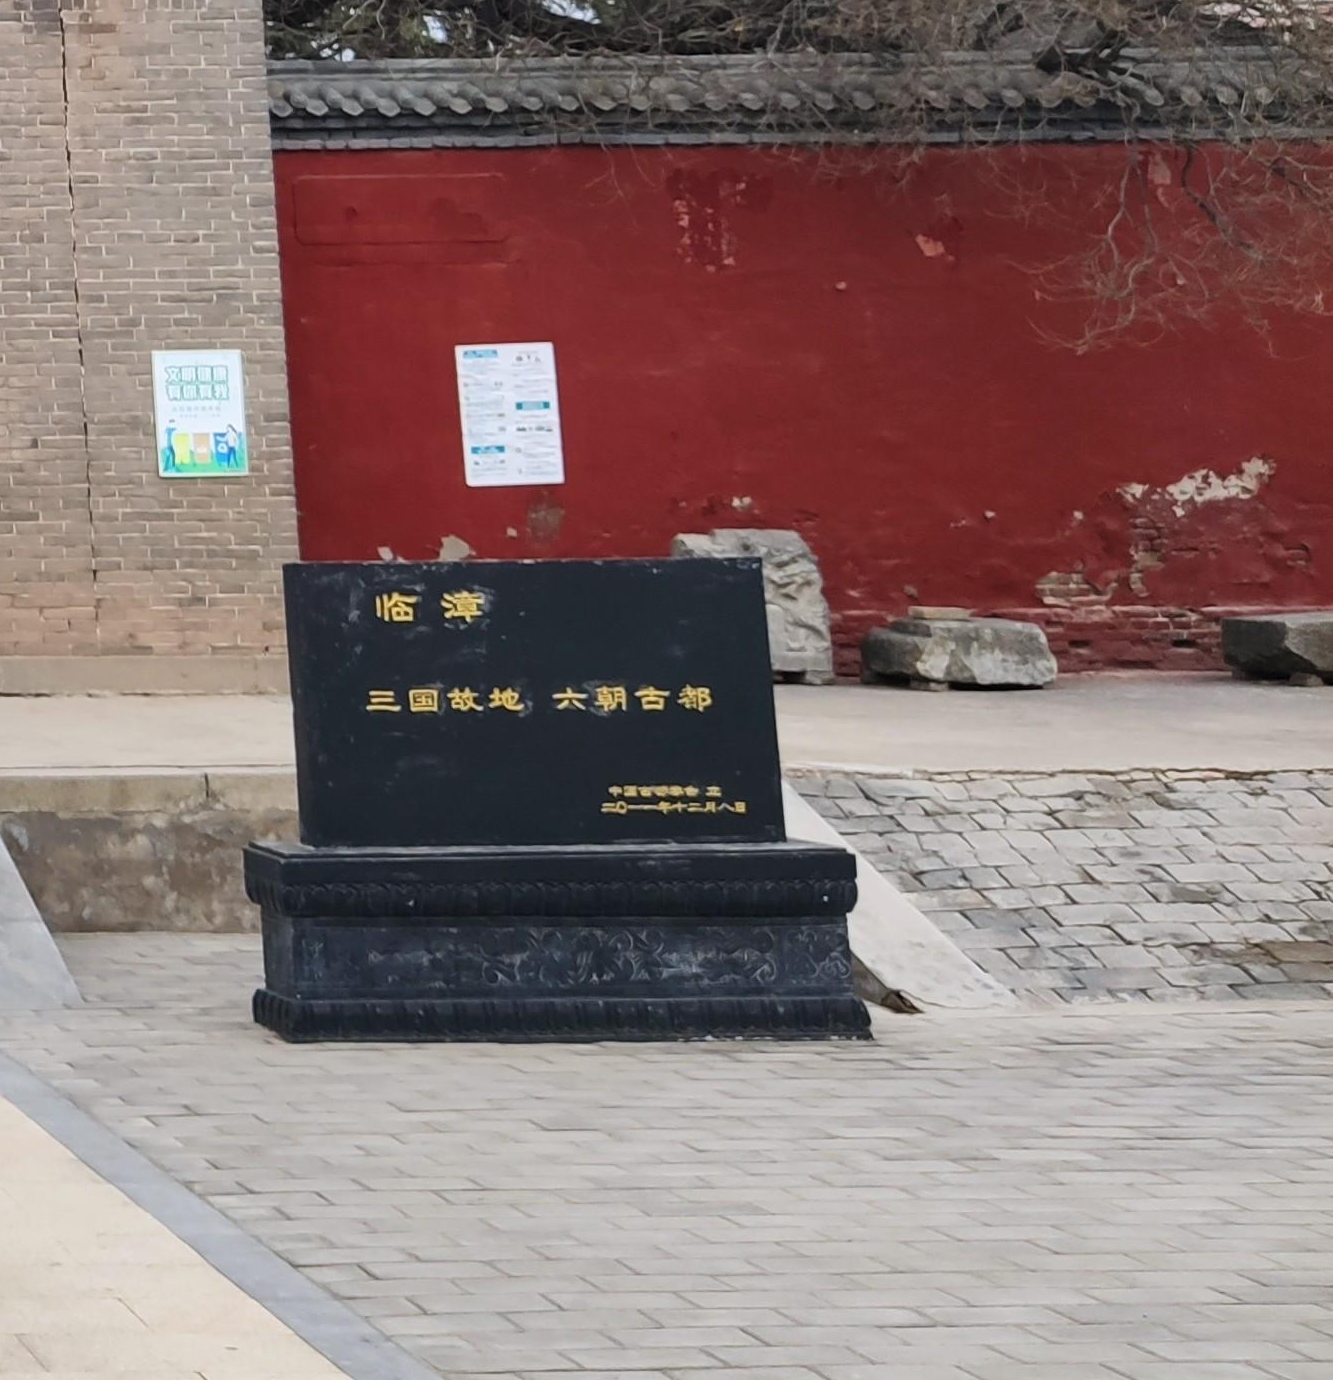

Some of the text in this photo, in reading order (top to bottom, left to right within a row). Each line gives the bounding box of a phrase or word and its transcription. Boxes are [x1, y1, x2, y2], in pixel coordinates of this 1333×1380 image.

[375, 590, 486, 624] 临漳
[365, 684, 715, 715] 三国故地 六朝古都
